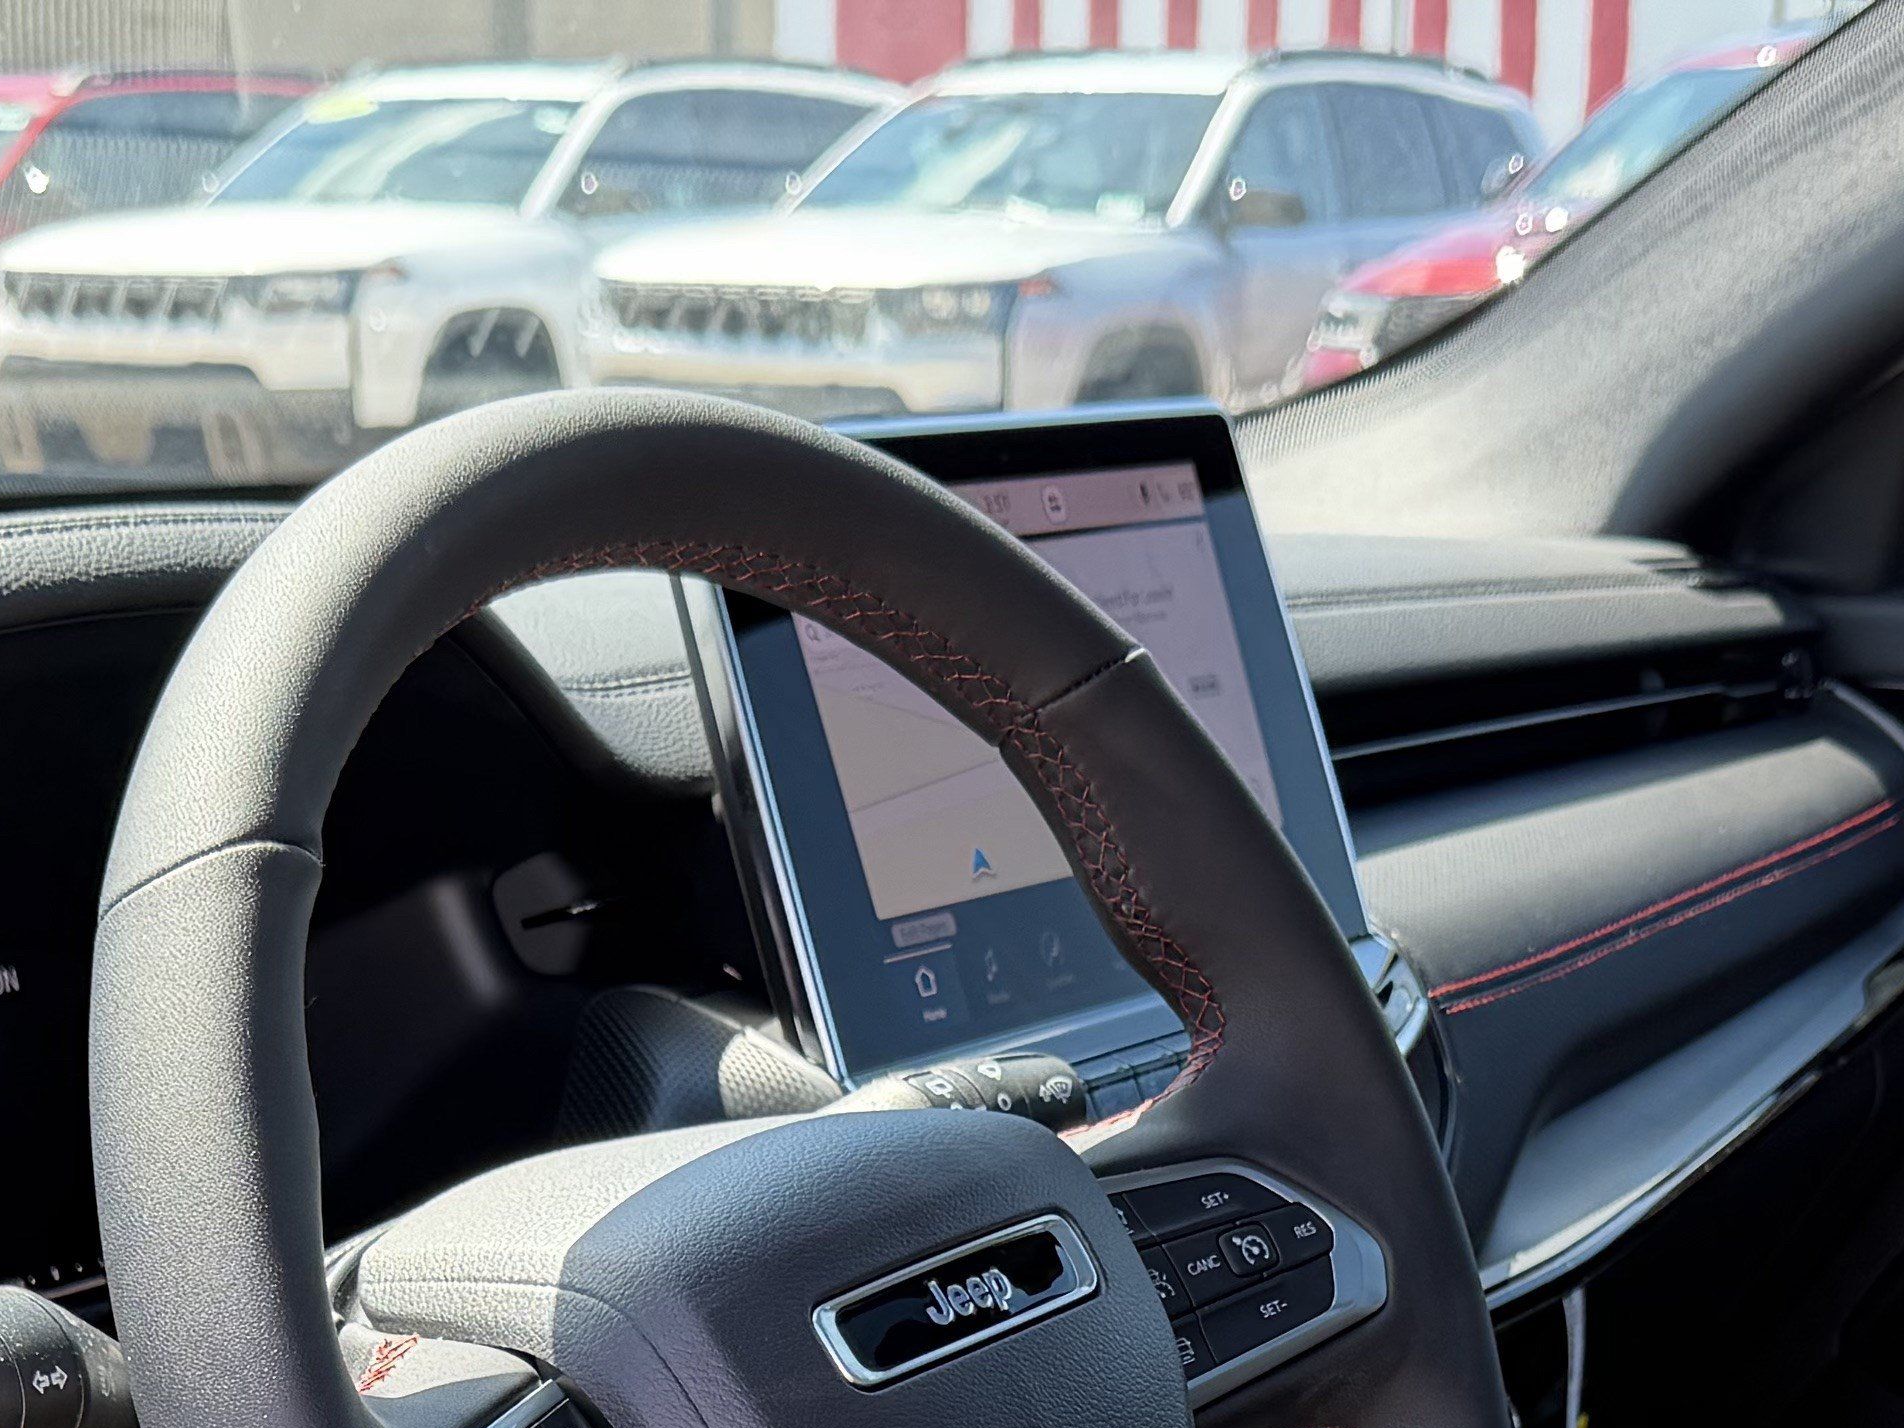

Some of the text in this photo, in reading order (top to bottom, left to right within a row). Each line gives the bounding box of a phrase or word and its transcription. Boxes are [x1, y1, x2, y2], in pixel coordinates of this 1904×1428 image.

[1292, 1220, 1318, 1239] RES
[1186, 1254, 1222, 1277] CANC
[925, 1267, 1013, 1326] Jeep
